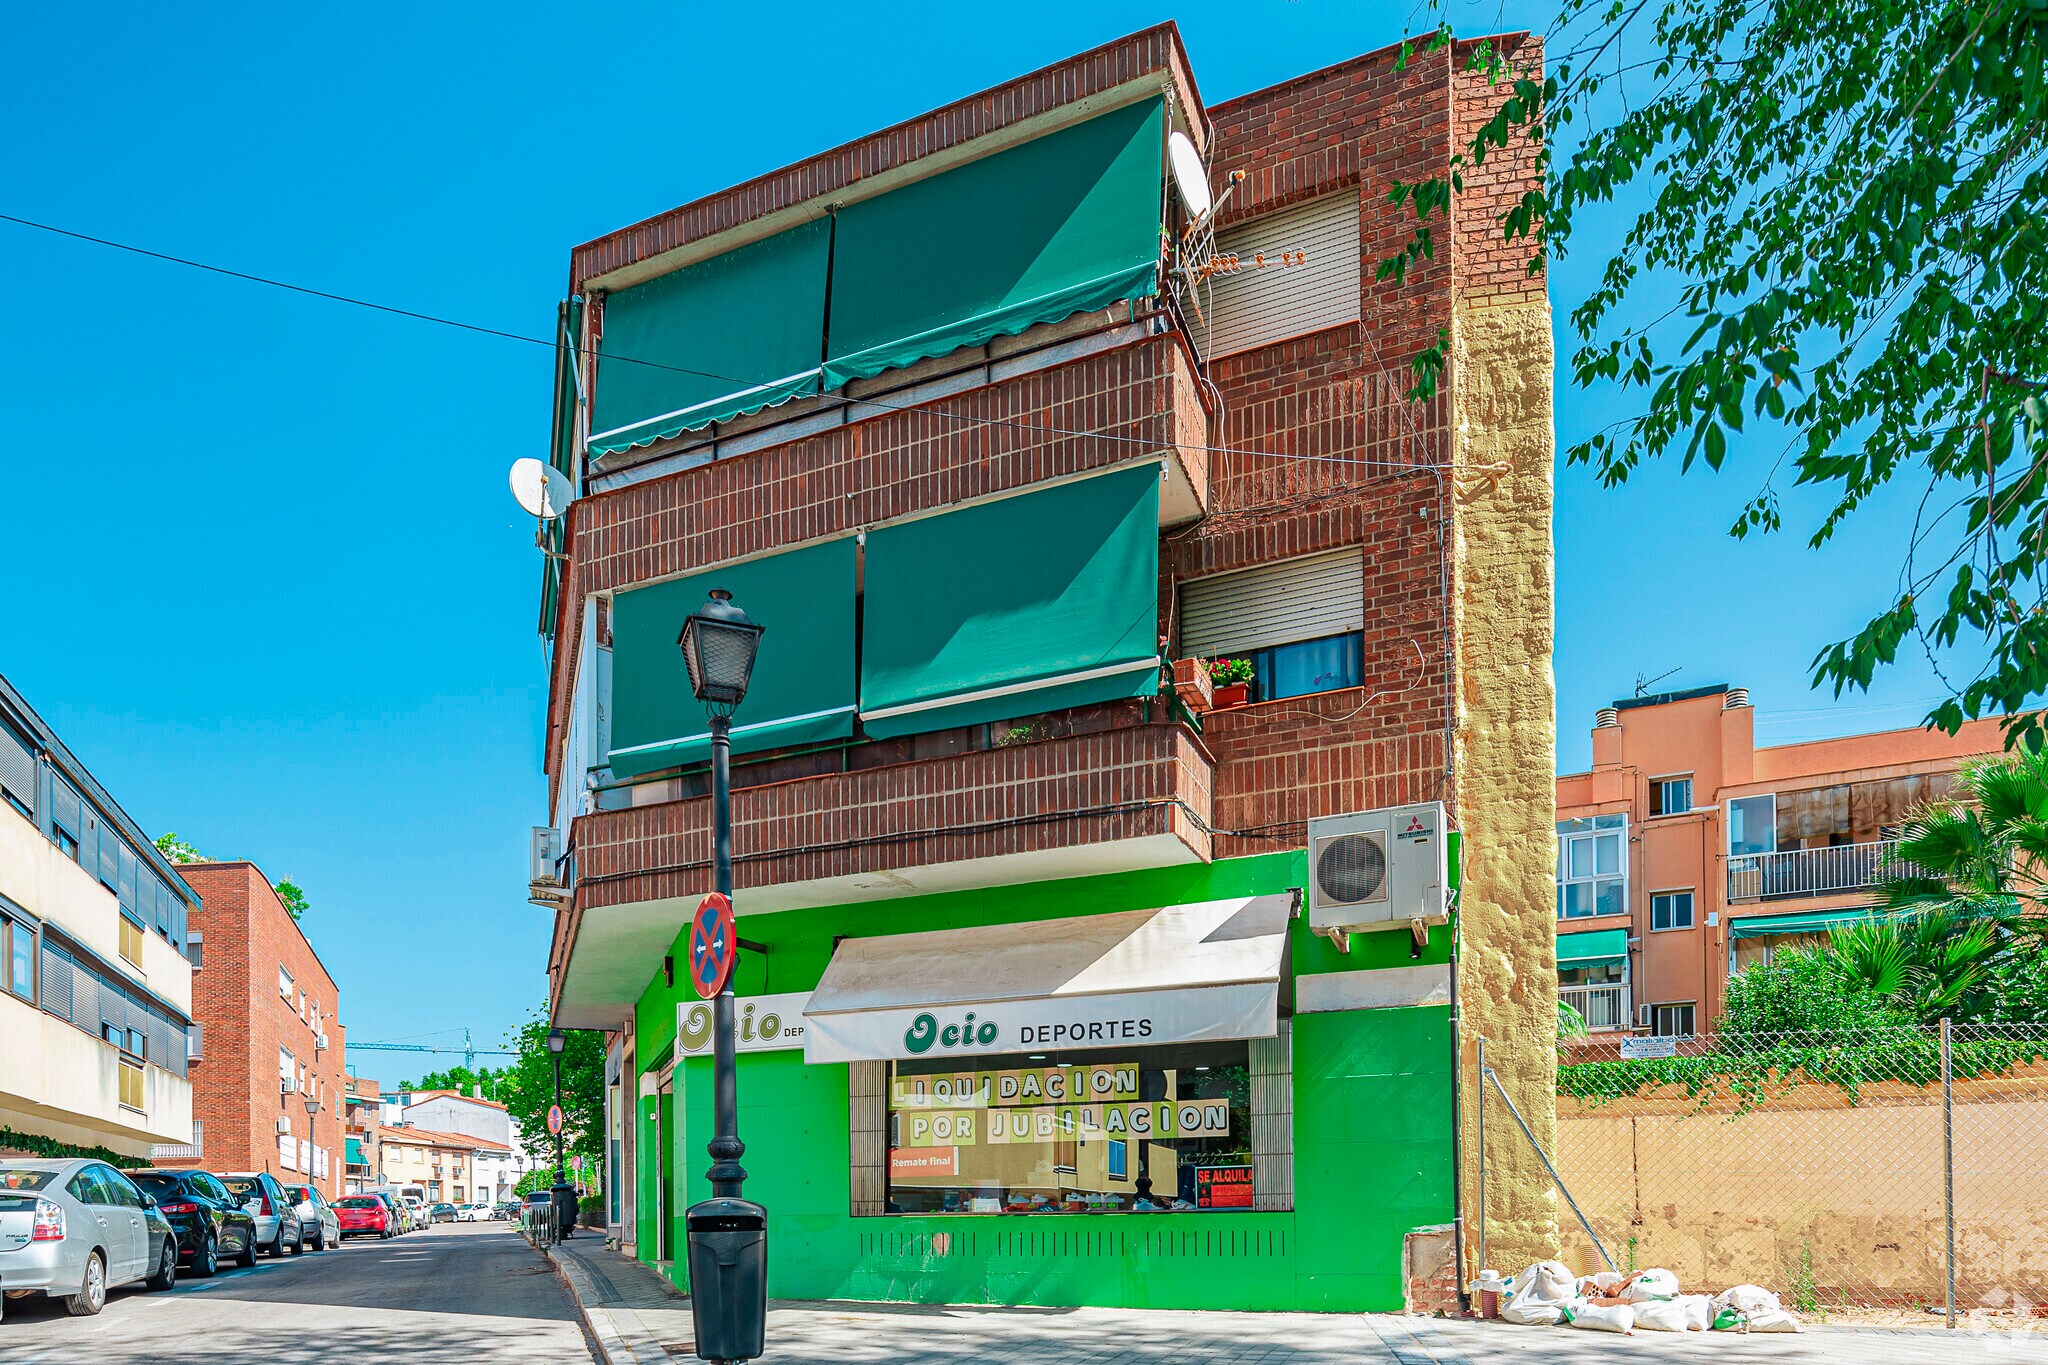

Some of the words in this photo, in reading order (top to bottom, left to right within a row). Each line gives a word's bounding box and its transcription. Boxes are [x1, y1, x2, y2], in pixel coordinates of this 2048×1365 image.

[679, 1003, 781, 1052] Oio
[904, 1011, 999, 1054] Ocio
[1020, 1019, 1153, 1044] DEPORTES
[893, 1069, 1137, 1104] LIQUIDACION
[913, 1116, 972, 1139] POR
[992, 1105, 1227, 1137] JUBILACION
[892, 1158, 928, 1167] Remate
[929, 1156, 951, 1166] final
[1198, 1170, 1210, 1183] SE
